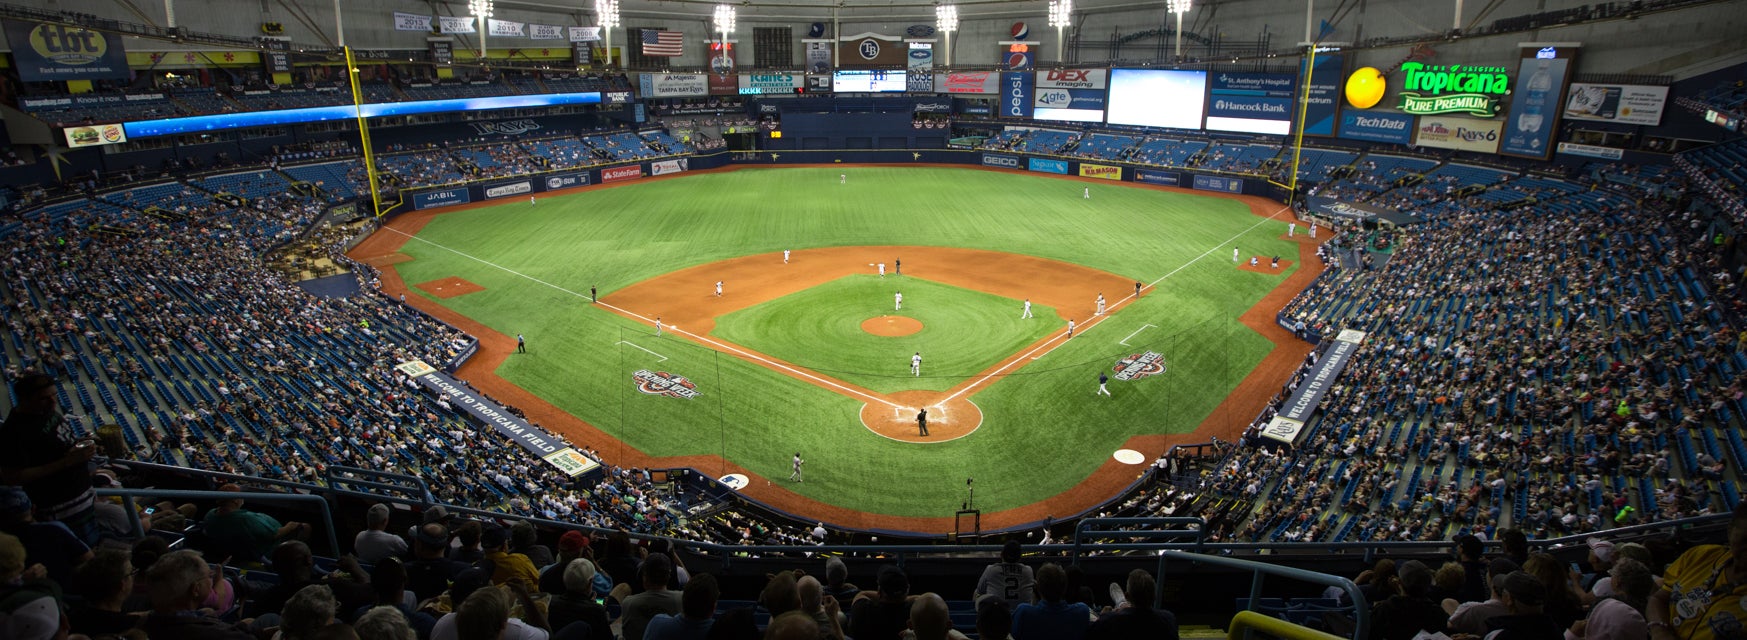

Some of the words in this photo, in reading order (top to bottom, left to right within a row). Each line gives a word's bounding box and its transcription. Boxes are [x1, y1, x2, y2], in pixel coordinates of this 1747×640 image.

[39, 22, 98, 52] tbt
[908, 70, 932, 81] ROSE
[1046, 69, 1091, 82] DEX
[1401, 62, 1508, 94] Tropicana
[1011, 77, 1024, 116] pepsi
[1050, 92, 1066, 102] gte
[1225, 102, 1262, 111] Hancock
[1263, 103, 1285, 112] Bank
[1405, 98, 1433, 111] PURE
[1434, 97, 1488, 110] PREMIUM
[1356, 117, 1379, 128] Tech
[1380, 118, 1406, 130] Data
[1486, 129, 1496, 141] 6
[984, 156, 1017, 166] GEICO
[427, 191, 456, 200] JABIL
[1287, 389, 1317, 418] WELCOME
[1309, 381, 1322, 391] TO
[1338, 342, 1350, 354] FIELD
[424, 374, 464, 397] WELCOME
[461, 395, 475, 404] TO
[472, 402, 525, 434] TROPICANA
[522, 432, 556, 453] FIELD
[1005, 578, 1018, 600] 2
